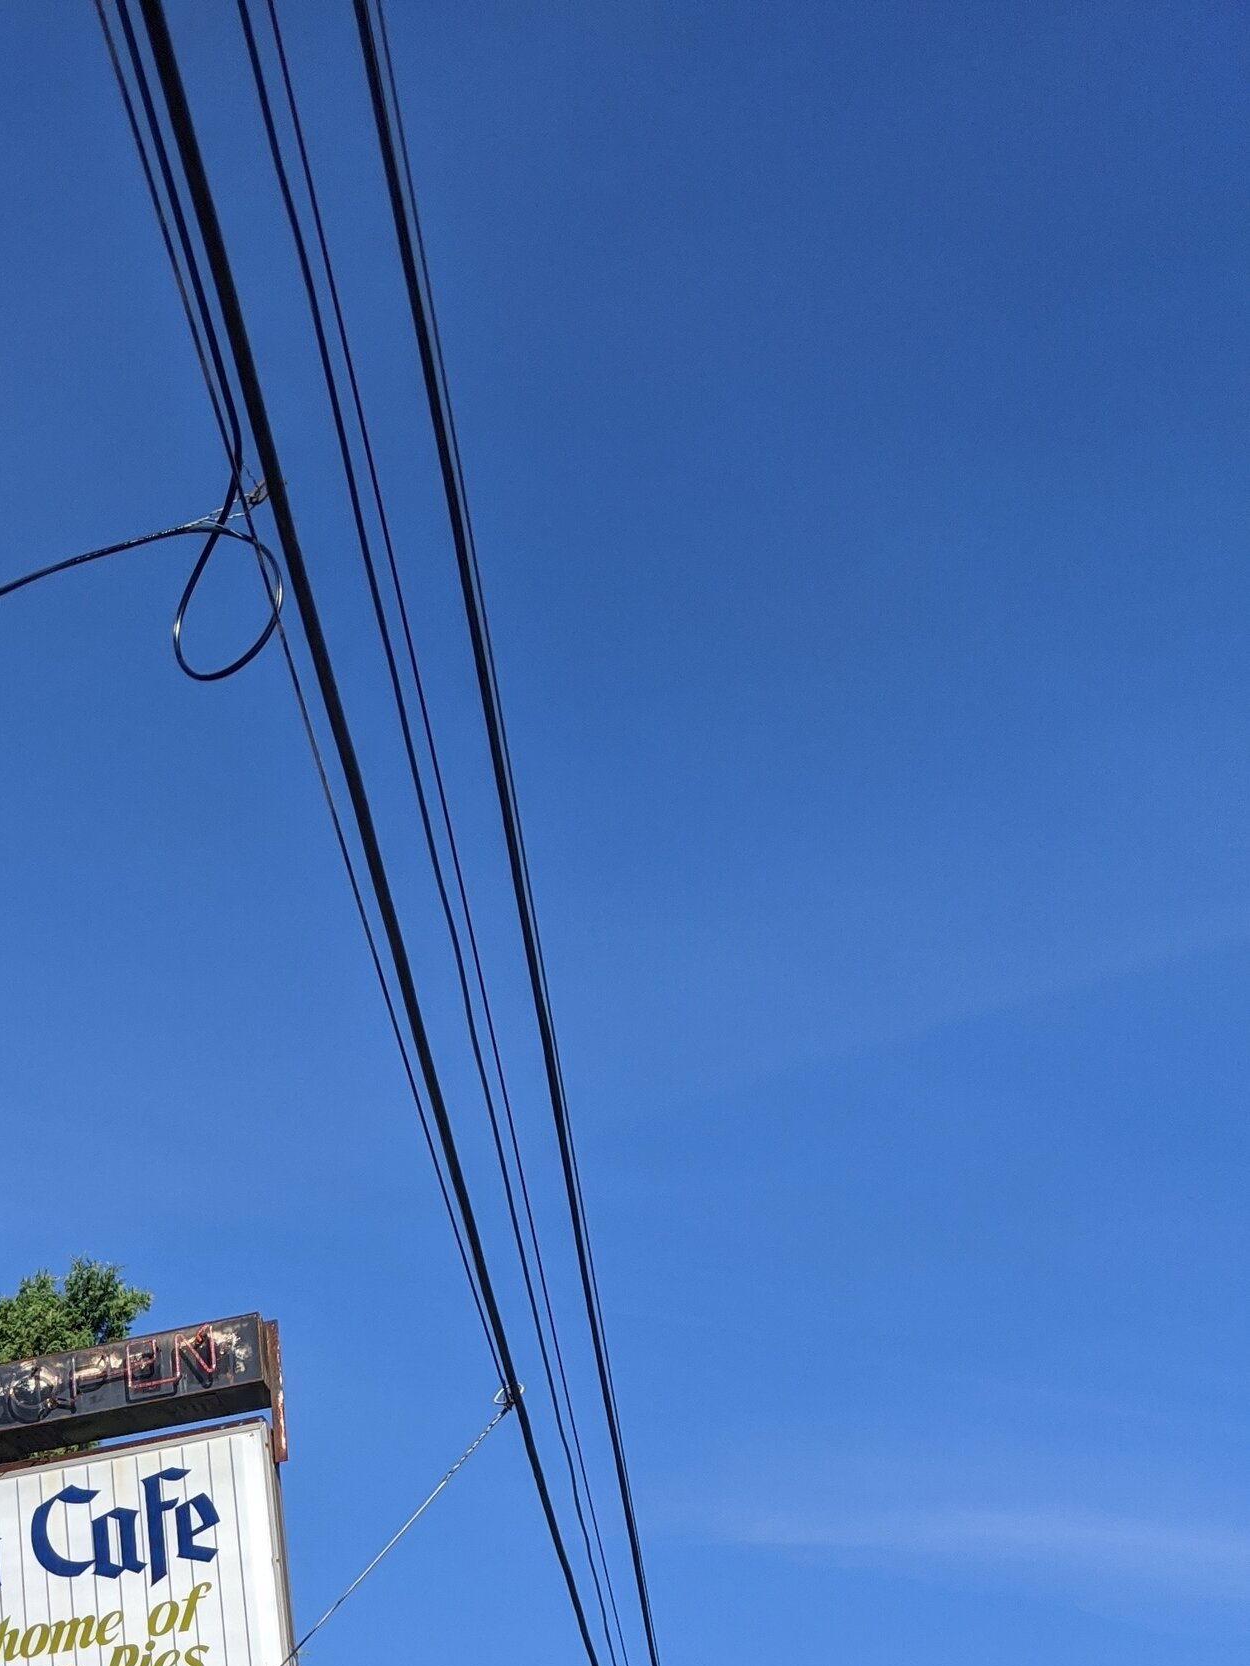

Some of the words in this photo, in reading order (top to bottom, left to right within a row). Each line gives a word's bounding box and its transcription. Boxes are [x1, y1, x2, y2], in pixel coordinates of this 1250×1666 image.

[7, 1323, 217, 1422] OPEN
[31, 1467, 220, 1587] Cafe
[147, 1581, 212, 1637] of
